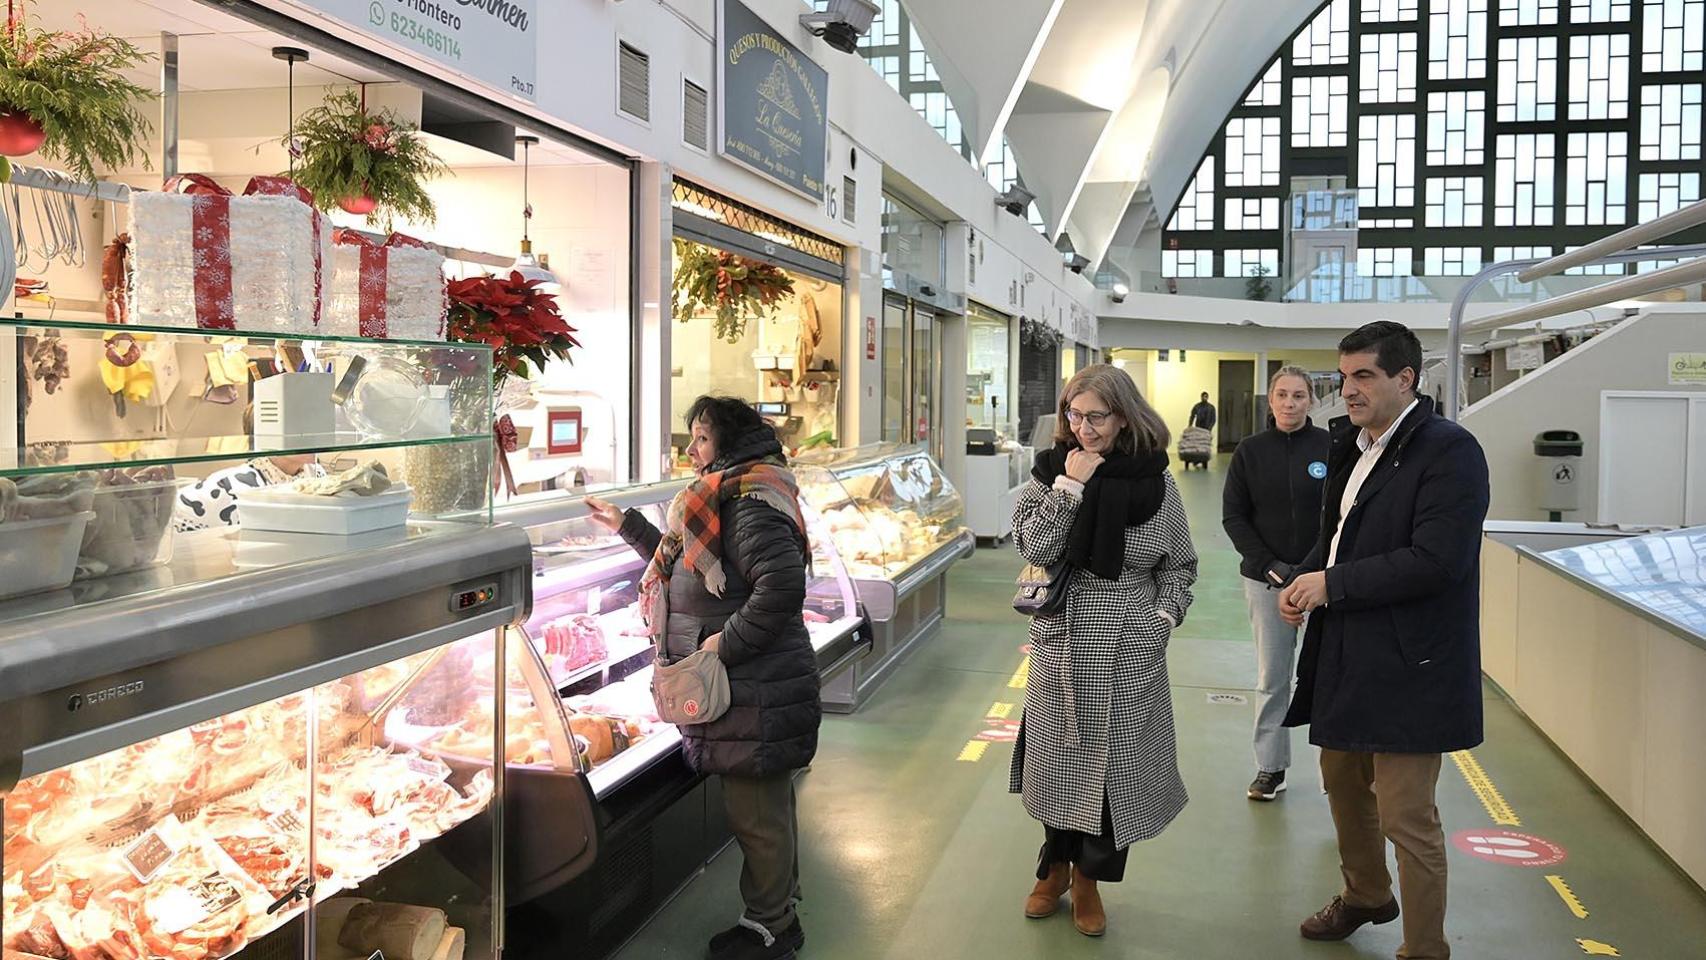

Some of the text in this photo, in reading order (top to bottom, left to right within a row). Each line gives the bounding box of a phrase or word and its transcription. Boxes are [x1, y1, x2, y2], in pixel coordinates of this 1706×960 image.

[456, 0, 529, 32] rmen
[390, 12, 462, 60] 623466114
[729, 33, 757, 65] QUESOS
[760, 33, 798, 73] PRODUCTOS
[511, 76, 534, 96] Pto.17
[826, 184, 837, 219] 16
[86, 680, 144, 704] CORECO
